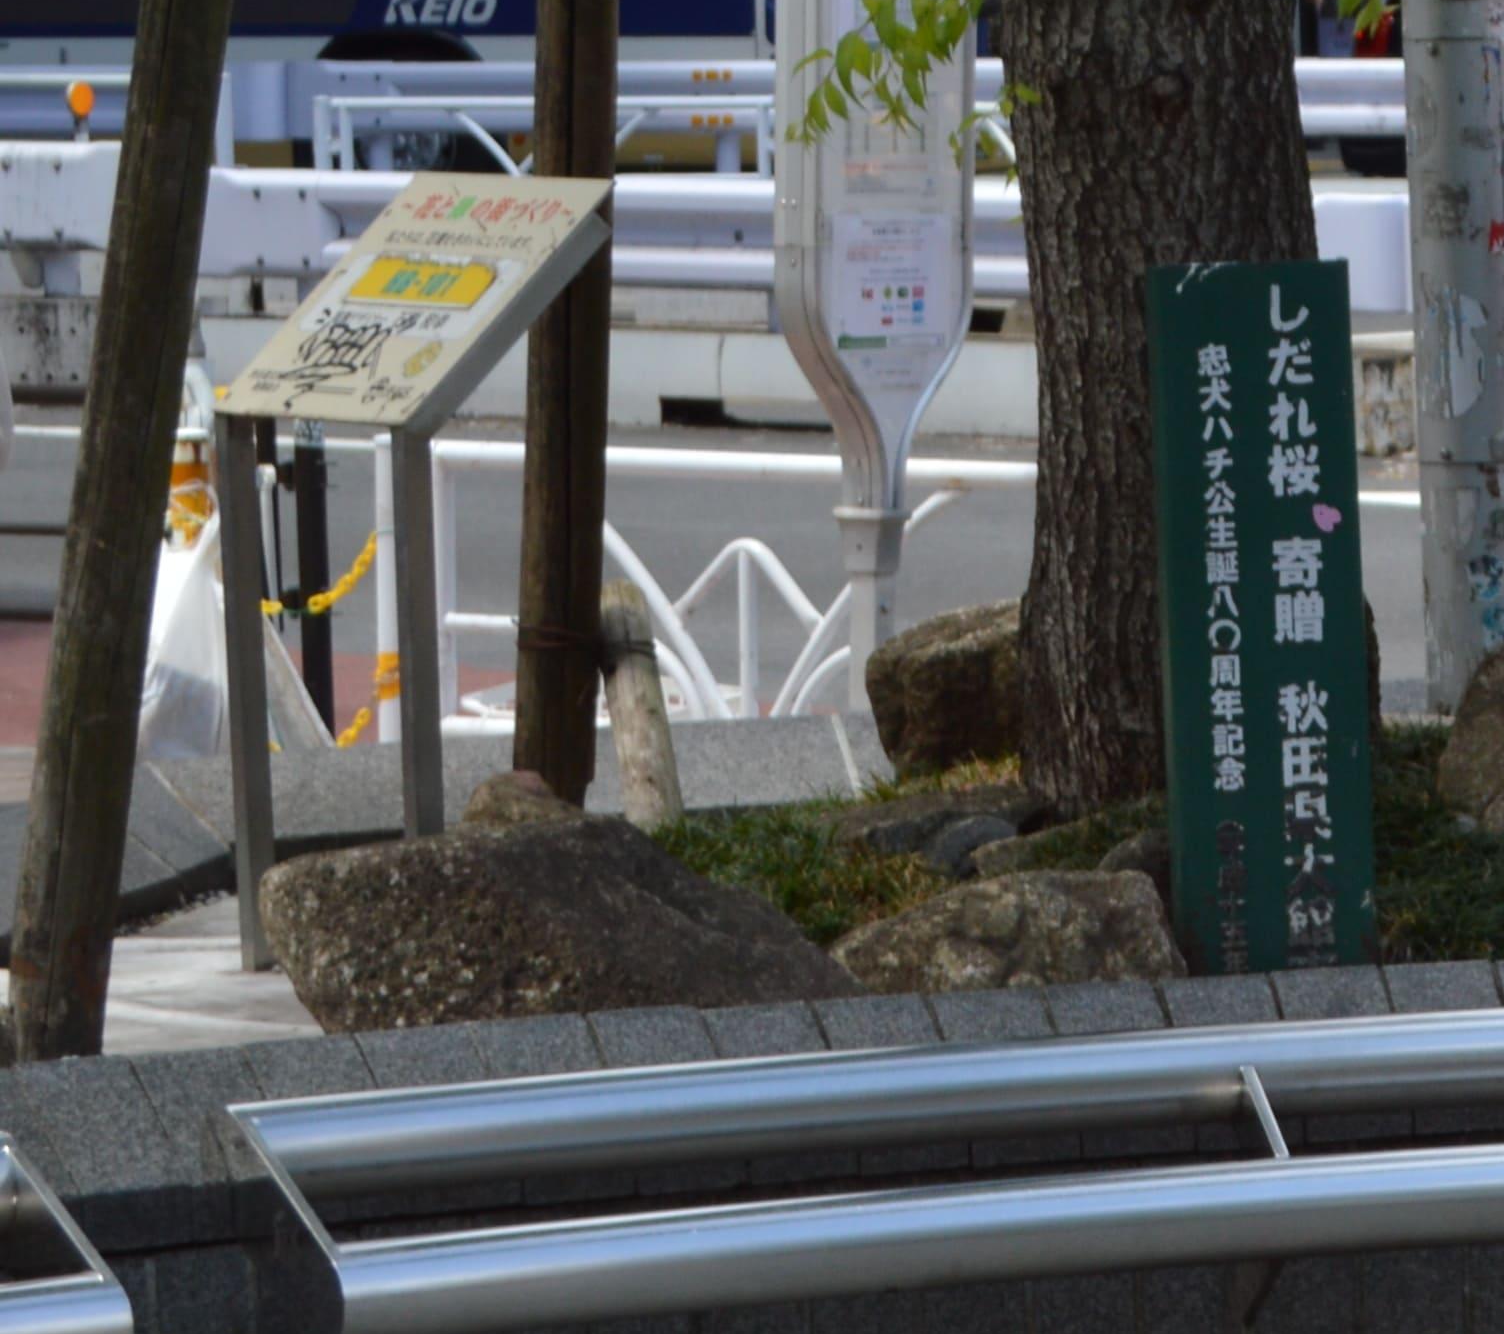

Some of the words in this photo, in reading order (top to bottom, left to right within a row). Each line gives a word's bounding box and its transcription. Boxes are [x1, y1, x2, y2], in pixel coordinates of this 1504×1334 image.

[1267, 283, 1321, 498] しだれ桜
[1271, 536, 1326, 644] 寄贈
